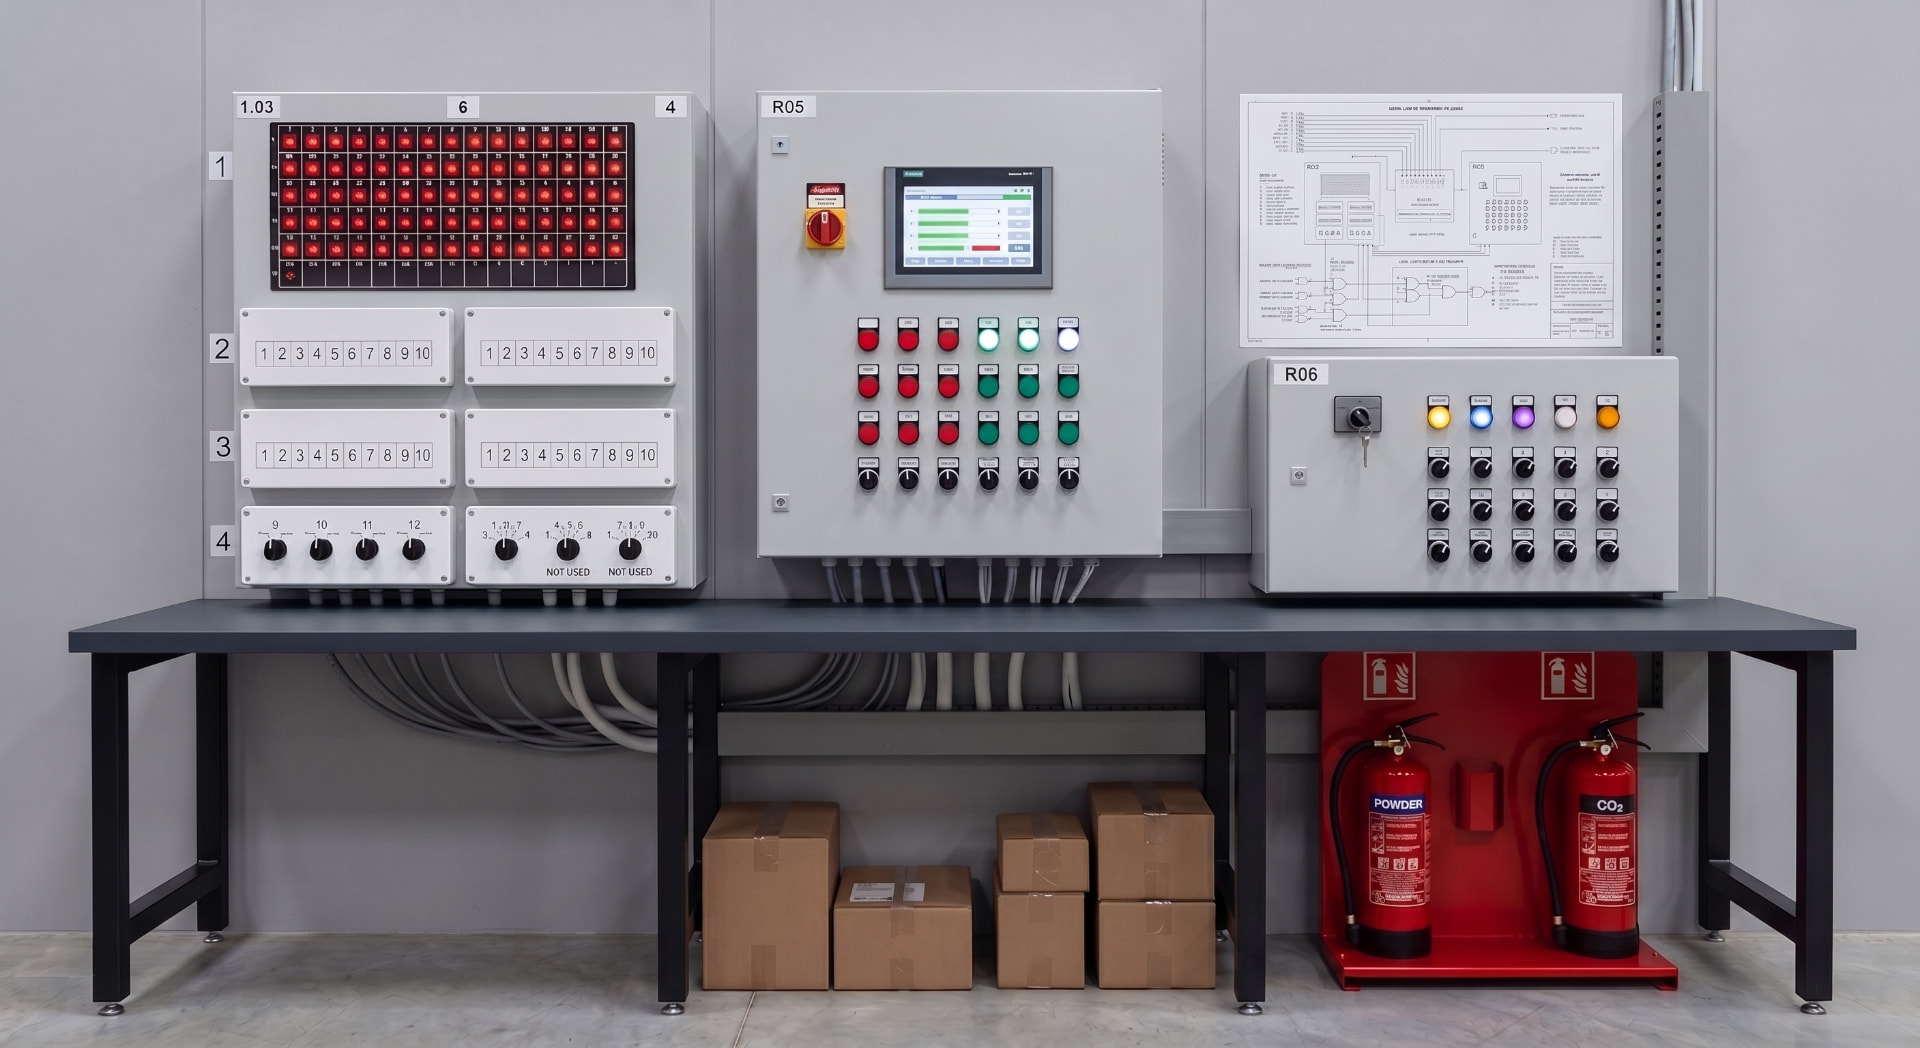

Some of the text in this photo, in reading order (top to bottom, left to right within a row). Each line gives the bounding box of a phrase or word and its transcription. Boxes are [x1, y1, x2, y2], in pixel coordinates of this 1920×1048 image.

[241, 100, 274, 114] 1.03
[458, 100, 468, 114] 6
[665, 100, 676, 114] 4
[772, 100, 804, 114] R05
[215, 155, 224, 178] 1
[215, 338, 230, 360] 2
[262, 346, 430, 360] 1 2 3 4 5 6 7 8 9 10
[486, 346, 654, 360] 1 2 3 4 5 6 7 8 9 10
[1285, 366, 1318, 382] R06
[216, 436, 231, 458] 3
[262, 448, 430, 462] 1 2 3 4 5 6 7 8 9 10
[486, 448, 656, 462] 1 2 3 4 5 6 7 8 9 10
[272, 520, 279, 530] 9
[316, 520, 328, 530] 10
[362, 520, 372, 530] 11
[408, 520, 421, 530] 12
[517, 521, 522, 529] 7
[568, 521, 572, 529] 5
[578, 521, 583, 529] 6
[215, 531, 231, 552] 4
[482, 531, 530, 539] 3 4
[587, 531, 592, 539] 8
[608, 531, 611, 539] 1
[546, 568, 590, 576] NOT USED
[608, 568, 653, 576] NOT USED
[1374, 798, 1424, 810] POWDER
[1596, 799, 1624, 813] CO2
